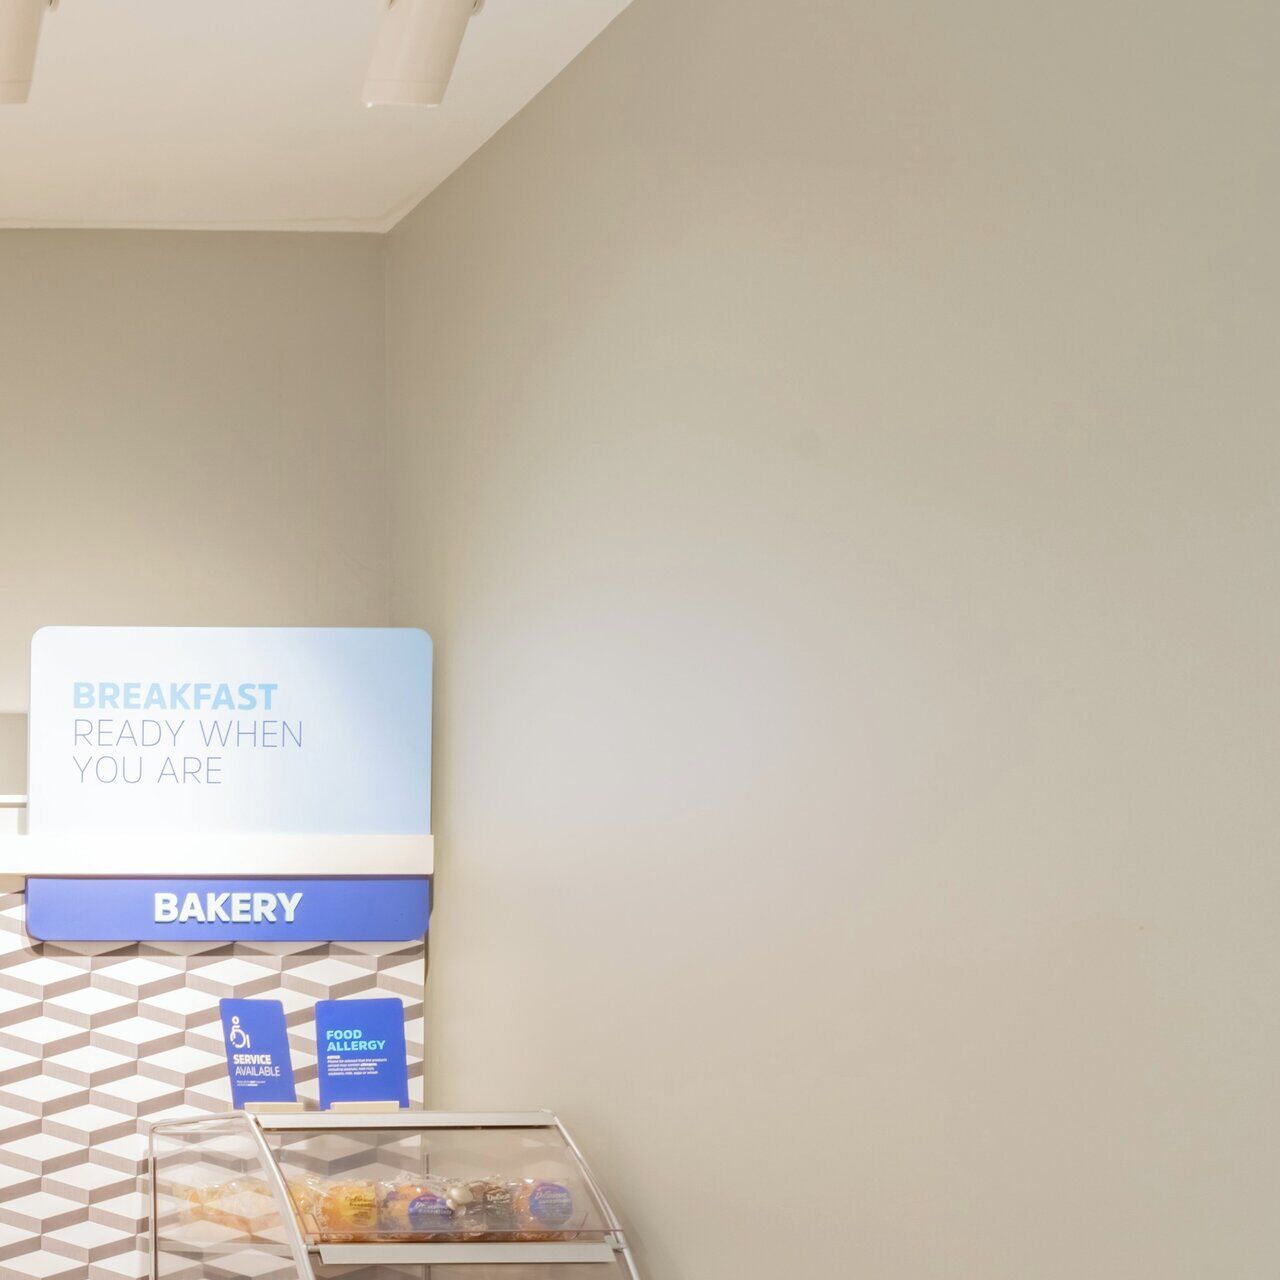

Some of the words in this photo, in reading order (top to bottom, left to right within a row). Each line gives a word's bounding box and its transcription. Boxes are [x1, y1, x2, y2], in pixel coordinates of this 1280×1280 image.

[73, 682, 278, 710] BREAKFAST
[73, 719, 186, 747] READY
[199, 720, 303, 748] WHEN
[72, 756, 142, 784] YOU
[158, 756, 222, 784] ARE
[154, 892, 303, 924] BAKERY
[327, 1030, 362, 1040] FOOD
[327, 1040, 386, 1052] ALLERGY
[233, 1054, 272, 1064] SERVICE
[235, 1066, 280, 1077] AVAILABLE
